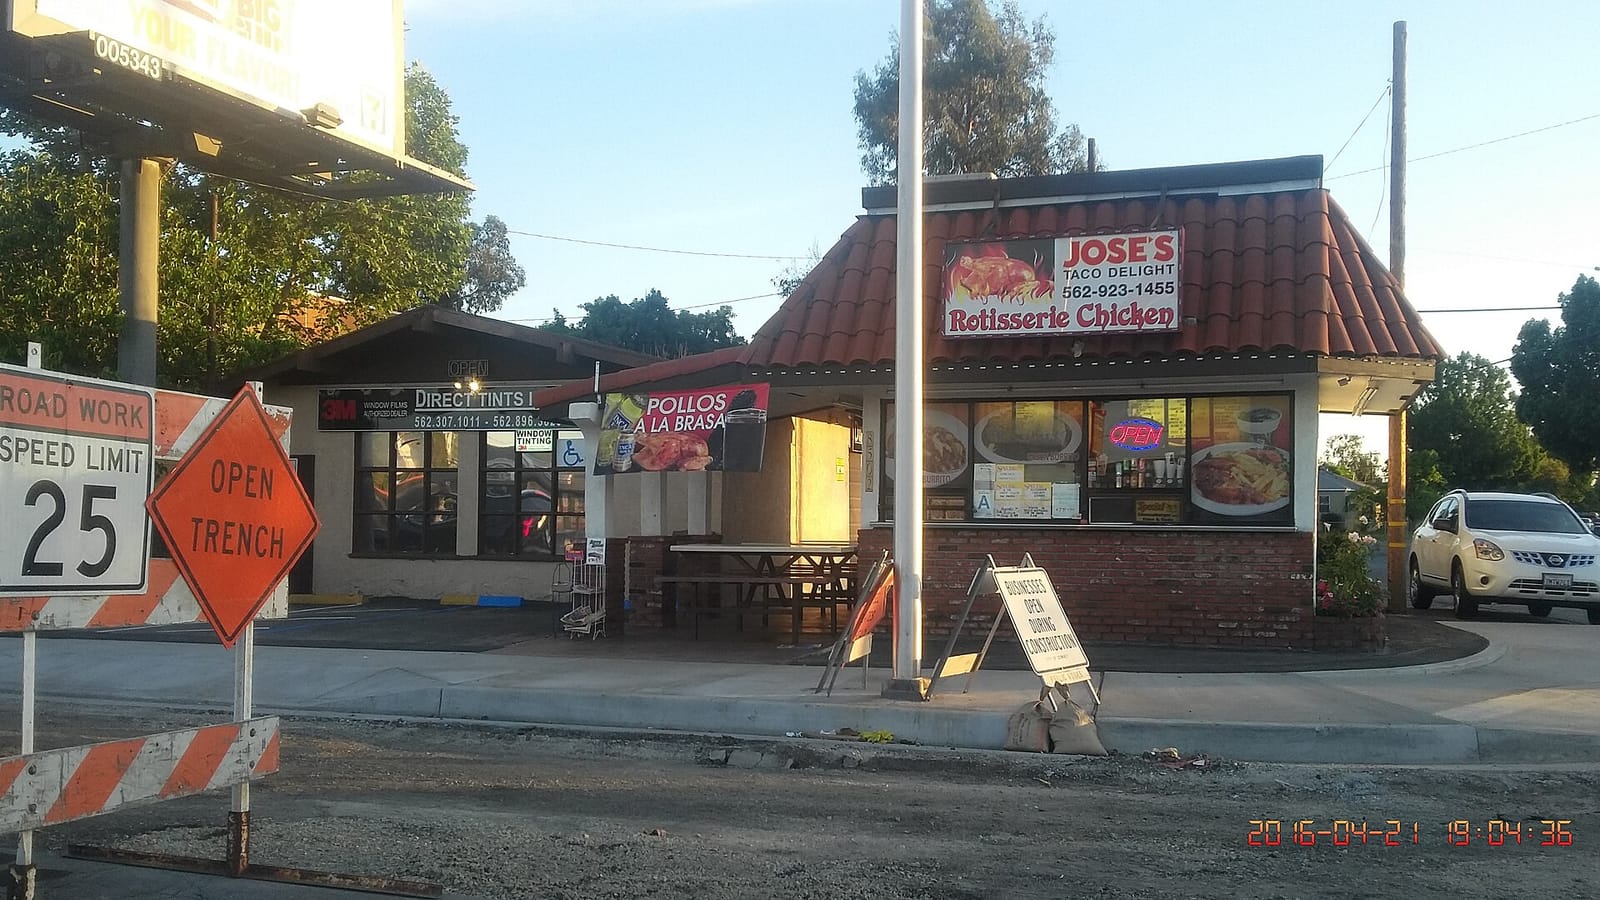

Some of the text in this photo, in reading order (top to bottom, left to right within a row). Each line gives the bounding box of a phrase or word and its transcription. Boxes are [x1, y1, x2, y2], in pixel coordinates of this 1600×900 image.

[129, 4, 197, 60] YOUR
[96, 35, 161, 79] 005343
[1063, 234, 1175, 268] JOSE'S
[1063, 263, 1175, 280] TACO DELIGHT
[1062, 281, 1175, 299] 562-923-1455
[949, 301, 1175, 332] Rotisserie Chicken
[450, 361, 487, 376] OPEN
[0, 387, 144, 429] ROAD WORK
[363, 401, 408, 409] WINDOW FILMS
[415, 389, 473, 408] DIRECT
[477, 391, 523, 407] TINTS
[647, 393, 727, 415] POLLOS
[322, 399, 357, 420] 3M
[414, 415, 481, 428] 562.307.1011
[493, 415, 561, 428] 562.896.
[633, 417, 646, 433] A
[651, 416, 669, 432] LA
[674, 413, 726, 431] BRASA
[517, 437, 552, 445] TINTING
[1109, 425, 1165, 445] OPEN
[0, 435, 143, 473] SPEED LIMIT
[211, 459, 274, 500] OPEN
[977, 495, 990, 509] A
[22, 480, 117, 577] 25
[191, 517, 284, 559] TRENCH
[1004, 579, 1047, 595] BUSINESSES
[1024, 598, 1045, 614] OPEN
[1029, 616, 1056, 634] DURING
[1025, 633, 1077, 655] CONSTRUCTION
